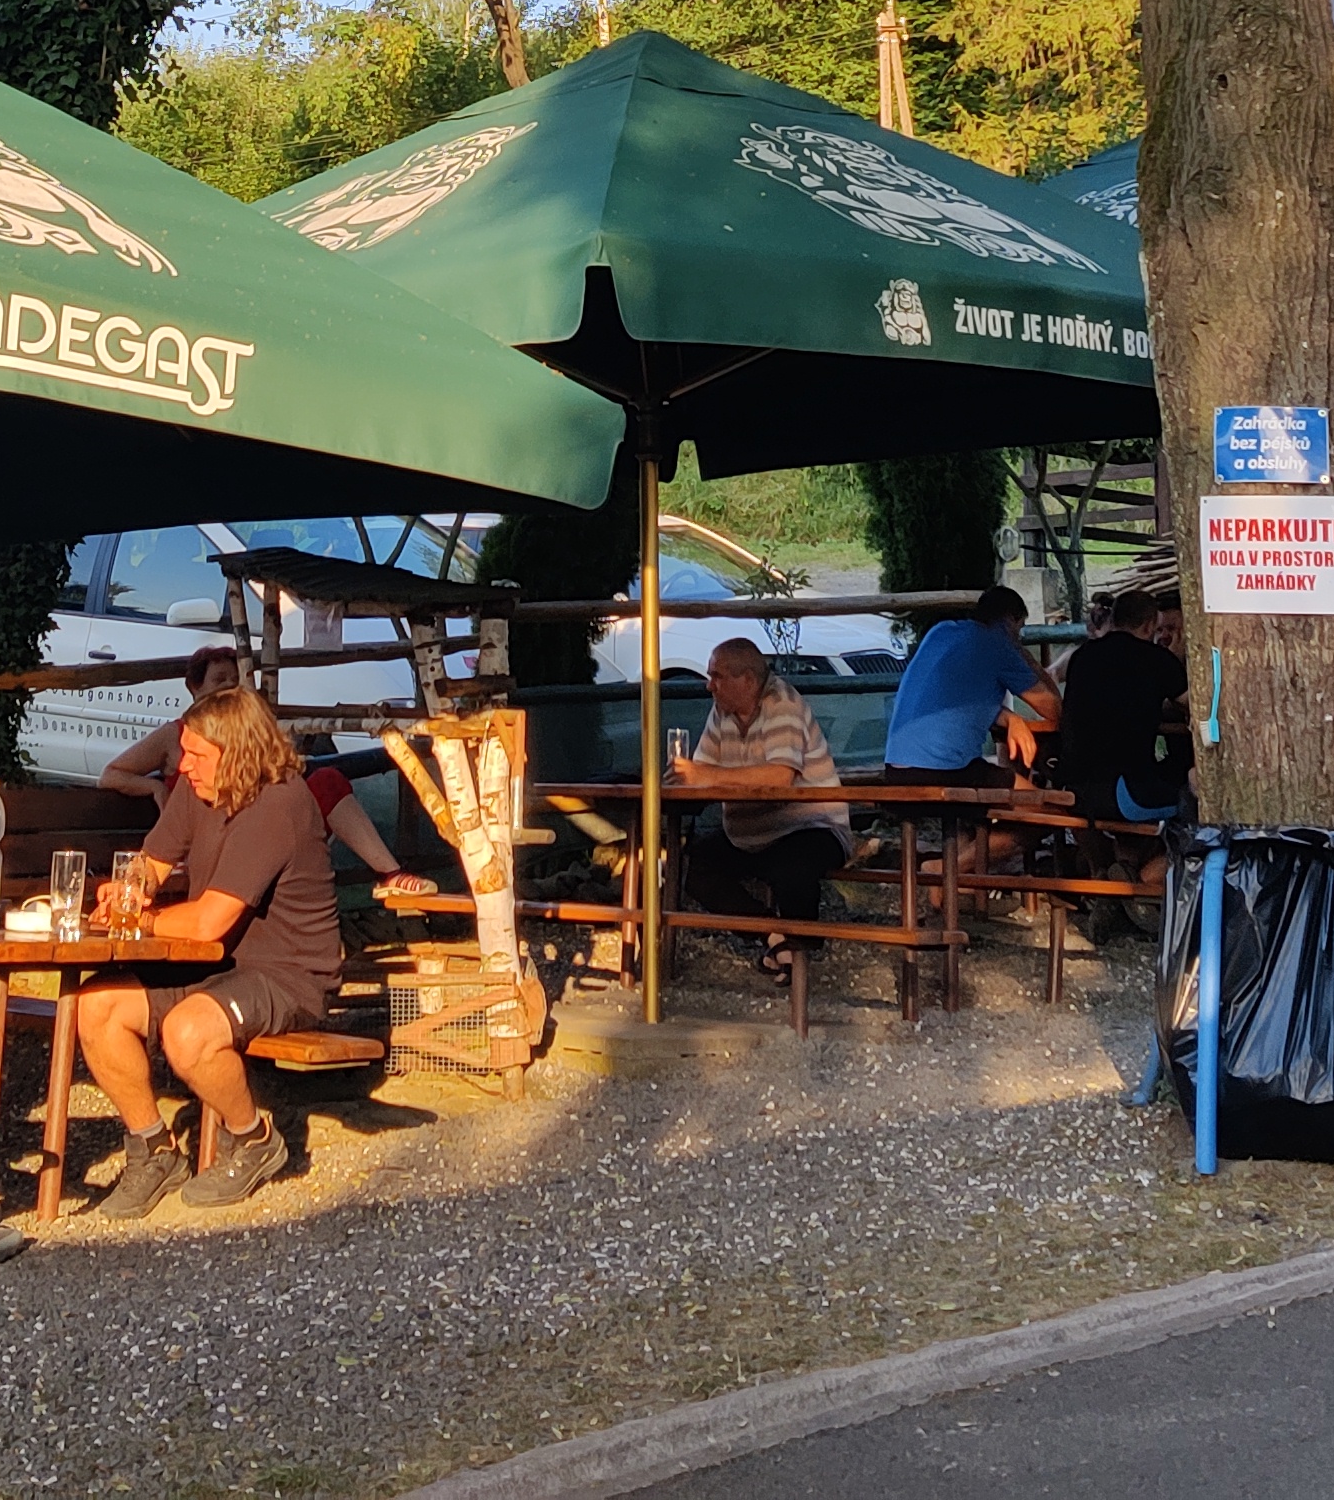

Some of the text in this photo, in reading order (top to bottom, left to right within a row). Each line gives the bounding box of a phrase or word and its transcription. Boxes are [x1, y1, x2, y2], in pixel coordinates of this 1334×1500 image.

[953, 297, 1014, 339] ŽIVOT
[1021, 313, 1043, 343] JE
[1047, 314, 1118, 354] HOŘKÝ.
[1233, 416, 1306, 431] Zahrádka
[1229, 435, 1257, 450] bez
[1234, 455, 1307, 473] a obsluhy
[1210, 550, 1245, 567] KOLA
[1249, 551, 1258, 566] V
[1237, 571, 1316, 591] ZAHRÁDKY
